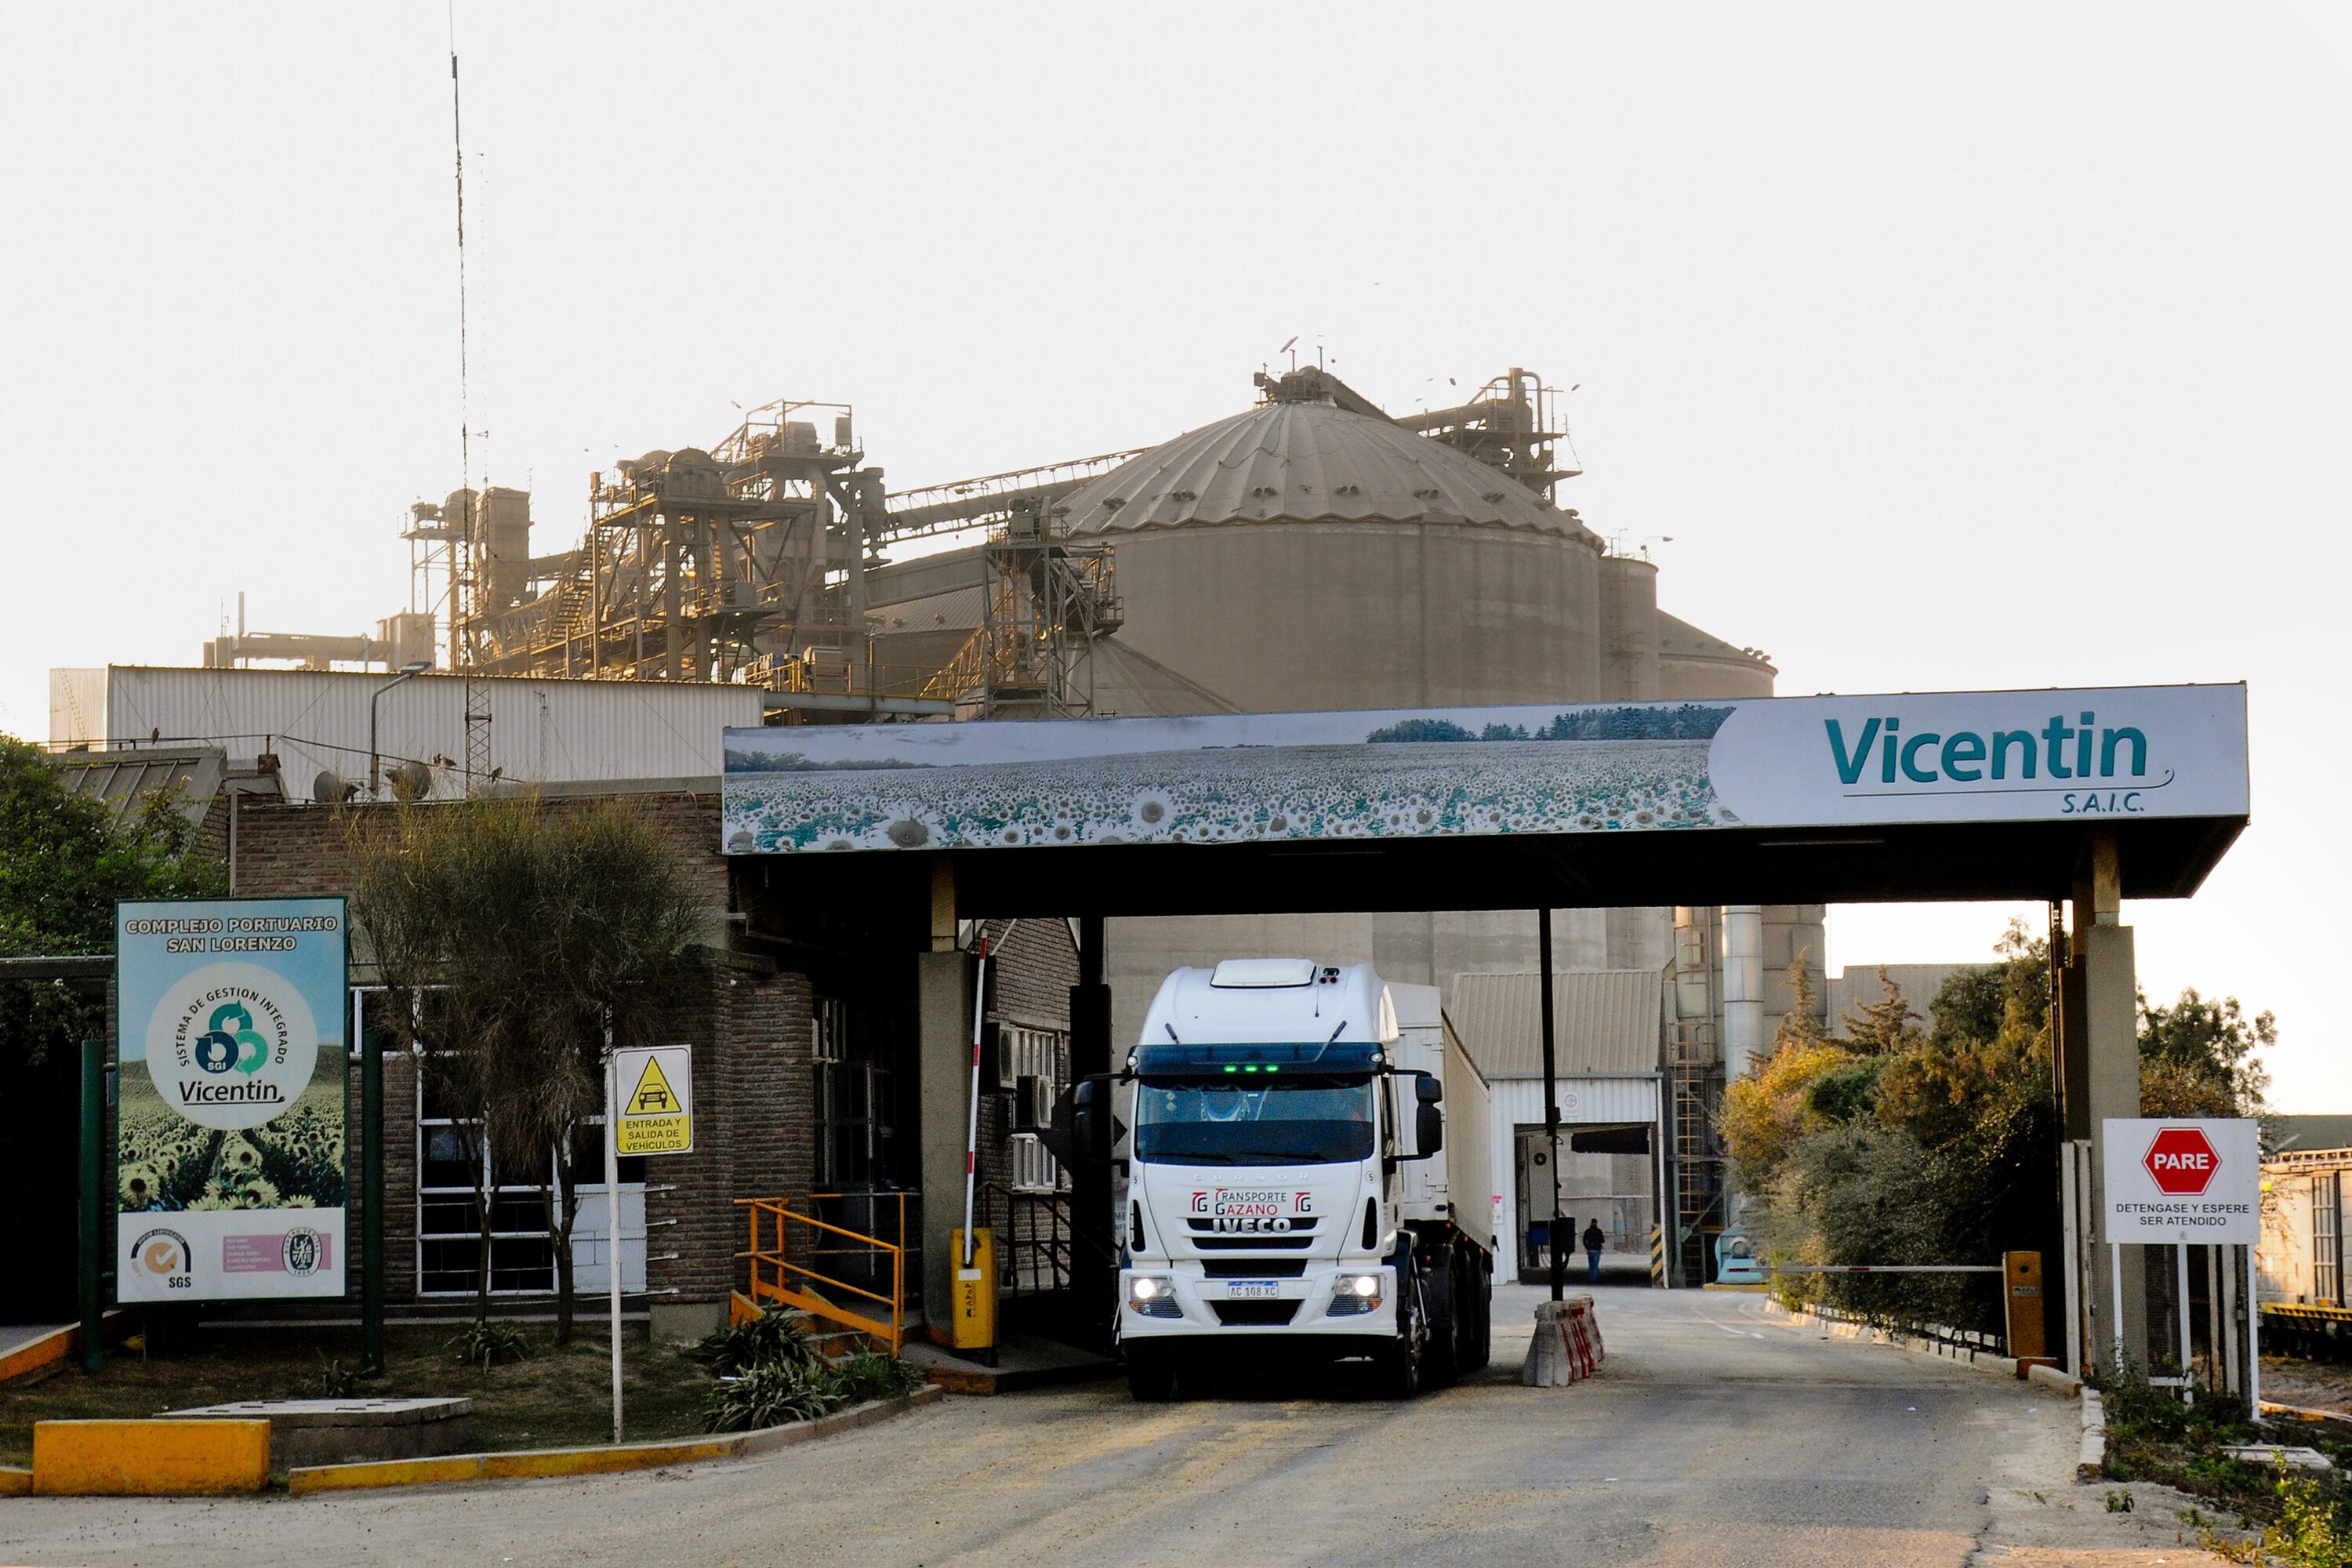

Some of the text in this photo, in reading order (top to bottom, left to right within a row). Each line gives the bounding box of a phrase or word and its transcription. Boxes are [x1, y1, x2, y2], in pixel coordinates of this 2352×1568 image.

[1824, 711, 2147, 785] Vicentin
[2062, 793, 2144, 813] S.A.I.C.
[125, 916, 338, 935] COMPLEJO PORTUARIO
[167, 936, 296, 953] SAN LORENZO
[176, 987, 289, 1067] SISTEMA DE GESTION INTEGRADO
[208, 1062, 226, 1071] SGI
[179, 1080, 278, 1102] Vicentin
[626, 1120, 673, 1129] ENTRADA
[628, 1129, 679, 1140] SALIDA DE
[2154, 1153, 2210, 1170] PARE
[1193, 1172, 1308, 1181] CURSOR
[1215, 1188, 1287, 1202] TRANSPORTE
[1215, 1203, 1278, 1215] GAZANO
[2116, 1204, 2249, 1213] DETENGASE Y ESPERE
[1213, 1218, 1291, 1234] IVECO
[2140, 1217, 2227, 1225] SER ATENDIDO
[169, 1276, 191, 1288] SGS
